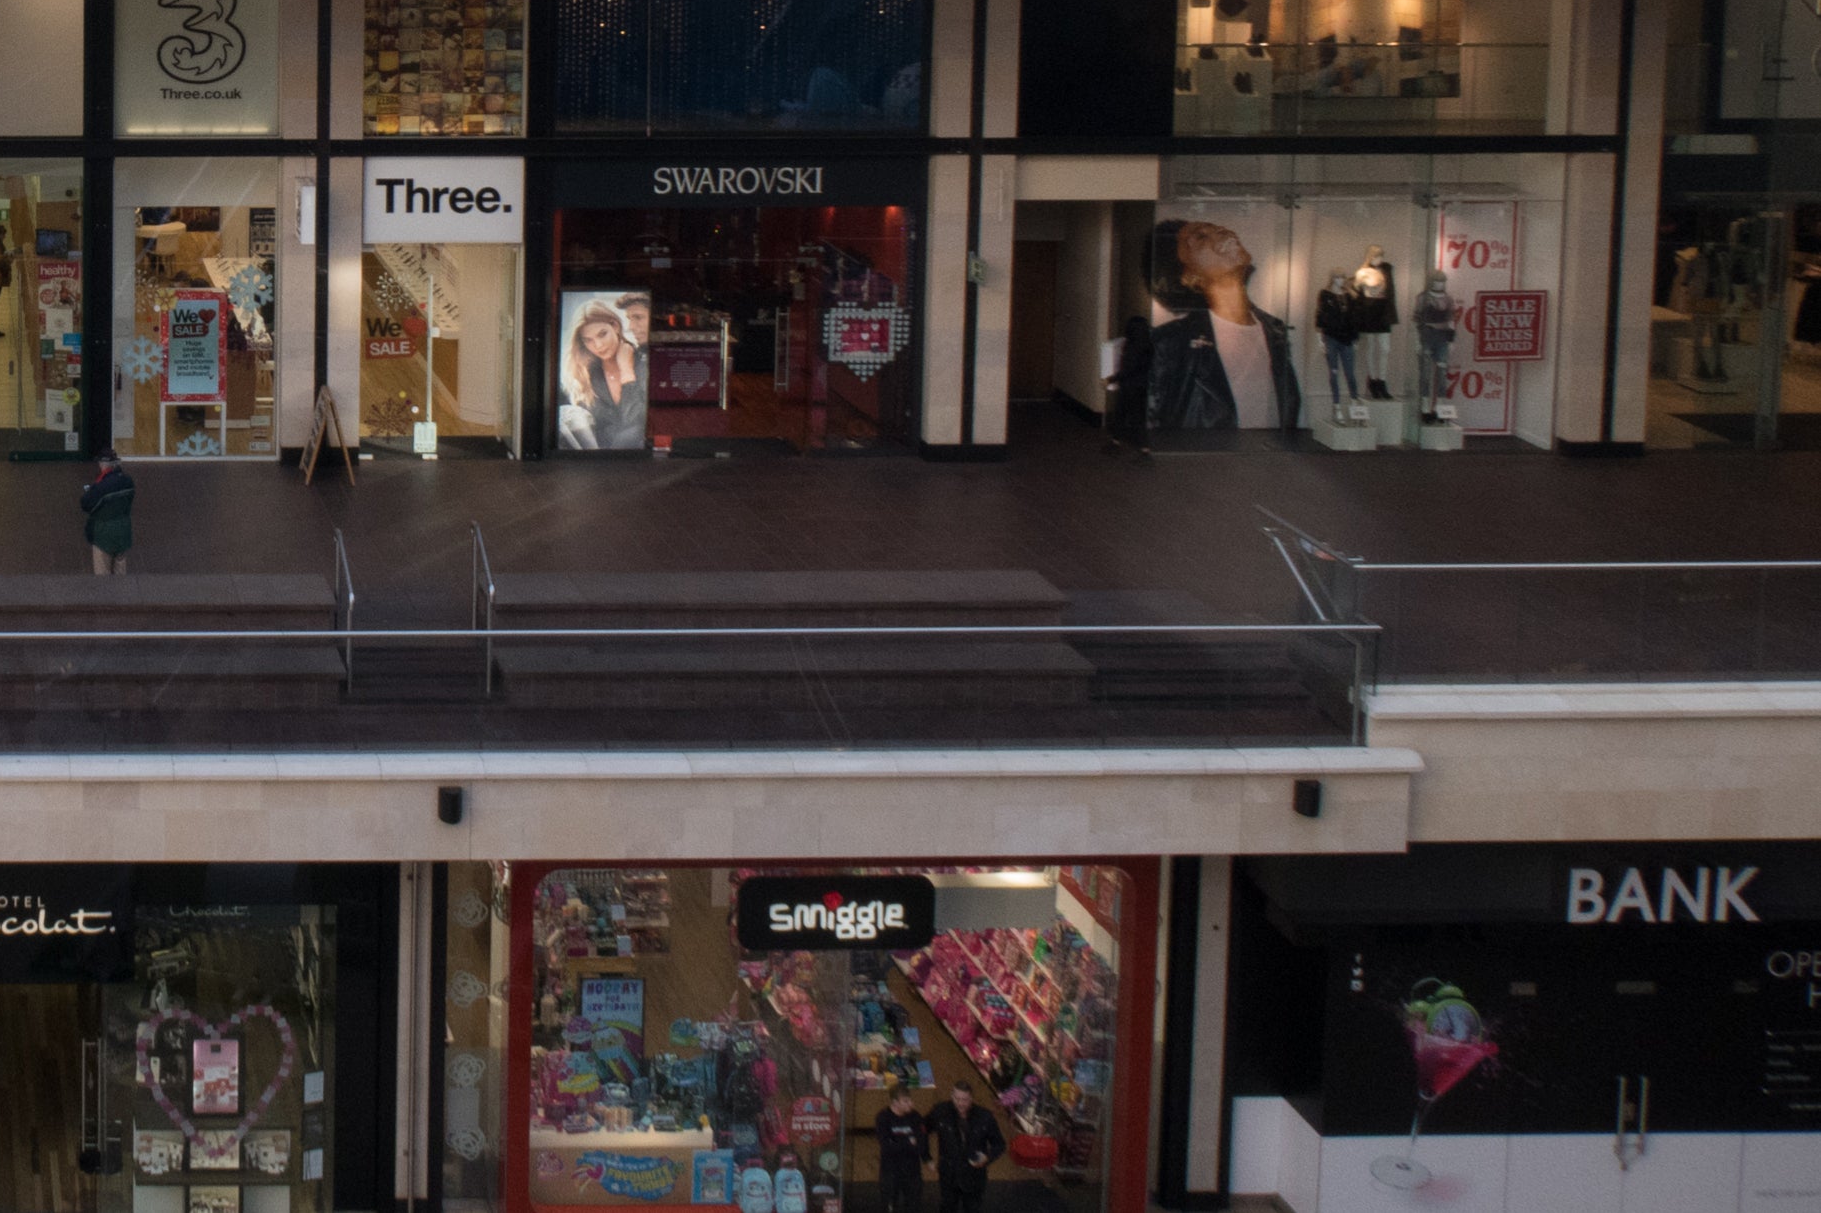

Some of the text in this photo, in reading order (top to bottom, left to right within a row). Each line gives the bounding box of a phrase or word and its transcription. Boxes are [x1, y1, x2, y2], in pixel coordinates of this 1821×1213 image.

[160, 88, 242, 100] Three.co.uk
[653, 167, 823, 194] SWAROVSKI
[376, 178, 512, 214] Three.
[1447, 240, 1509, 269] 70%
[40, 263, 76, 279] healthy
[1490, 259, 1508, 269] off
[1485, 300, 1536, 313] SALE
[173, 309, 200, 323] We
[1485, 314, 1536, 329] NEW
[175, 325, 204, 336] SALE
[366, 318, 401, 337] We
[1484, 329, 1533, 341] LINES
[370, 341, 410, 355] SALE
[1484, 341, 1532, 352] ADDED
[1446, 370, 1503, 399] 70%
[1567, 866, 1761, 923] BANK
[769, 900, 906, 940] smiggle
[803, 1122, 831, 1130] store
